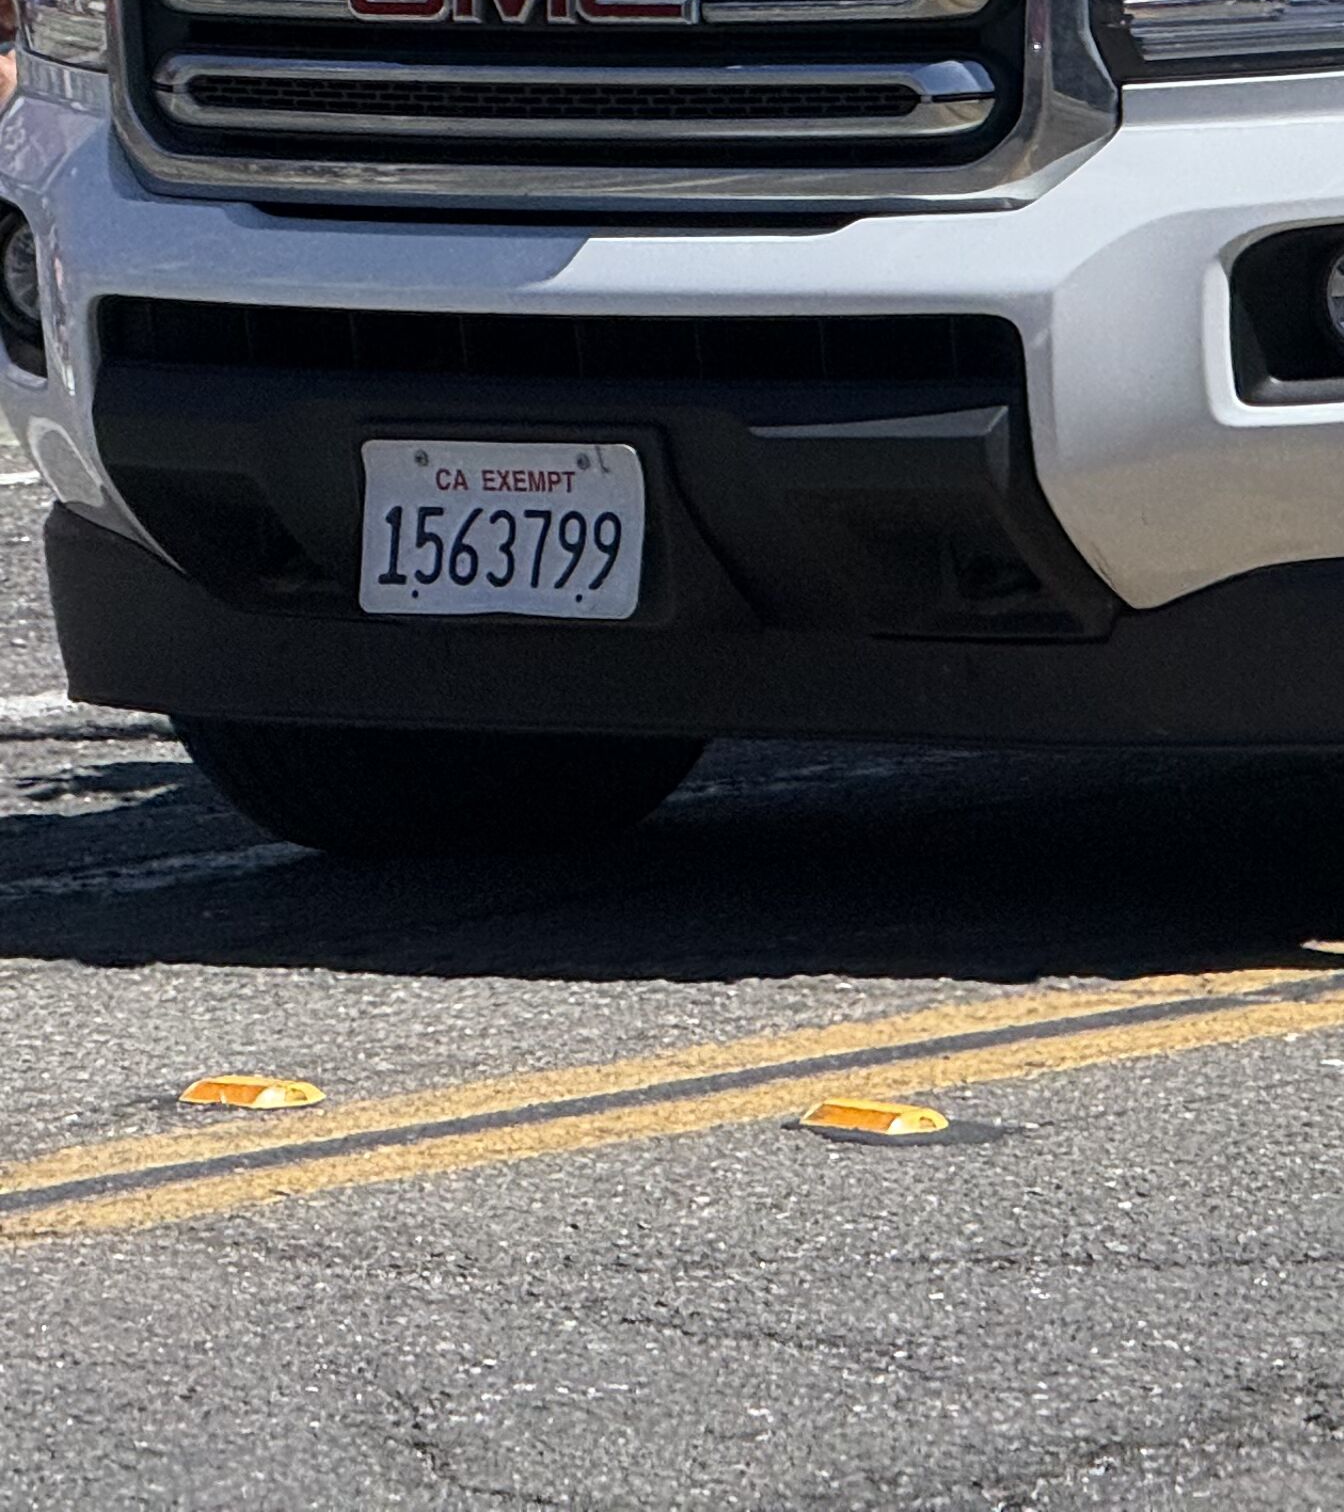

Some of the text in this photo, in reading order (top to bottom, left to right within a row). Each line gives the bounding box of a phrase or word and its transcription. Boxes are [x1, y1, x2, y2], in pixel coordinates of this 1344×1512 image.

[435, 468, 576, 494] CA EXEMPT
[377, 505, 623, 590] 1563799
